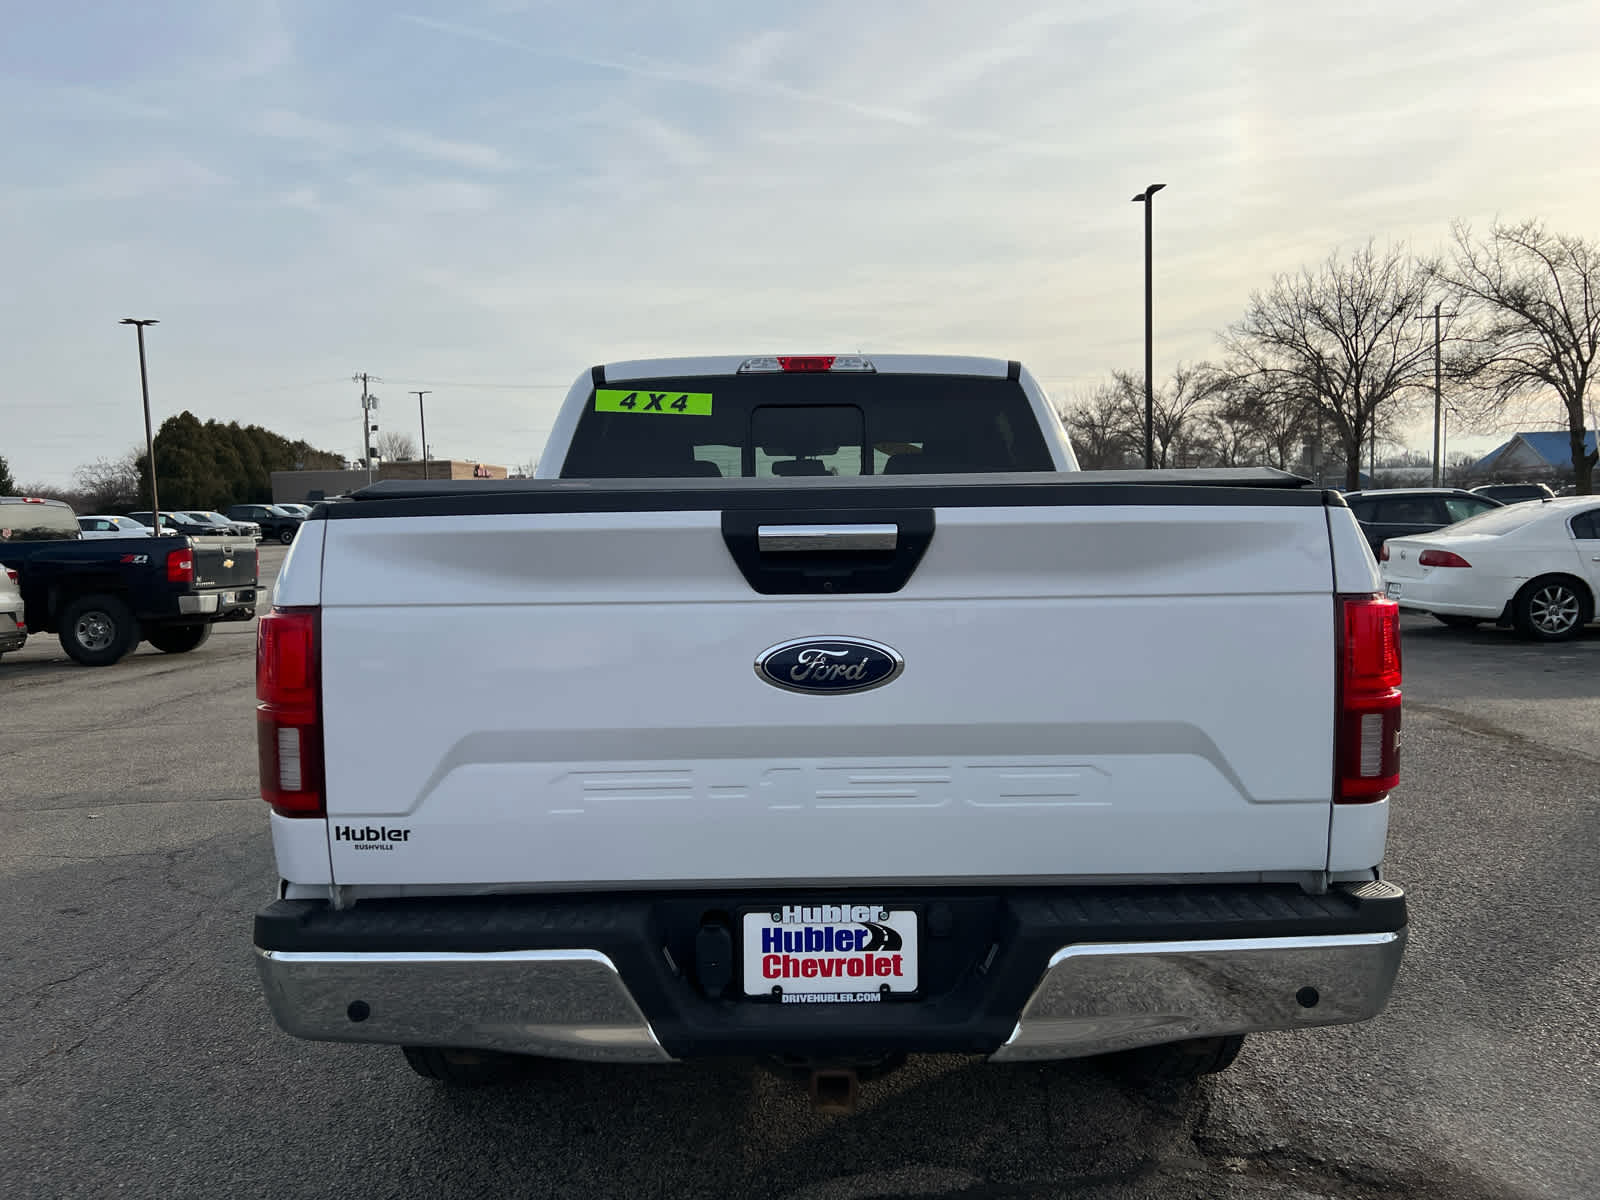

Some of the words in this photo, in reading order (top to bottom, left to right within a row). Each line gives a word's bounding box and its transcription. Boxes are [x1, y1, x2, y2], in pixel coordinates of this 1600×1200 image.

[790, 648, 869, 681] Ford
[335, 825, 411, 841] Hubler
[781, 904, 884, 924] Hubler
[761, 927, 868, 953] Hubler
[761, 953, 904, 979] Chevrolet
[781, 992, 881, 1003] DRIVEHUBLER.COM
